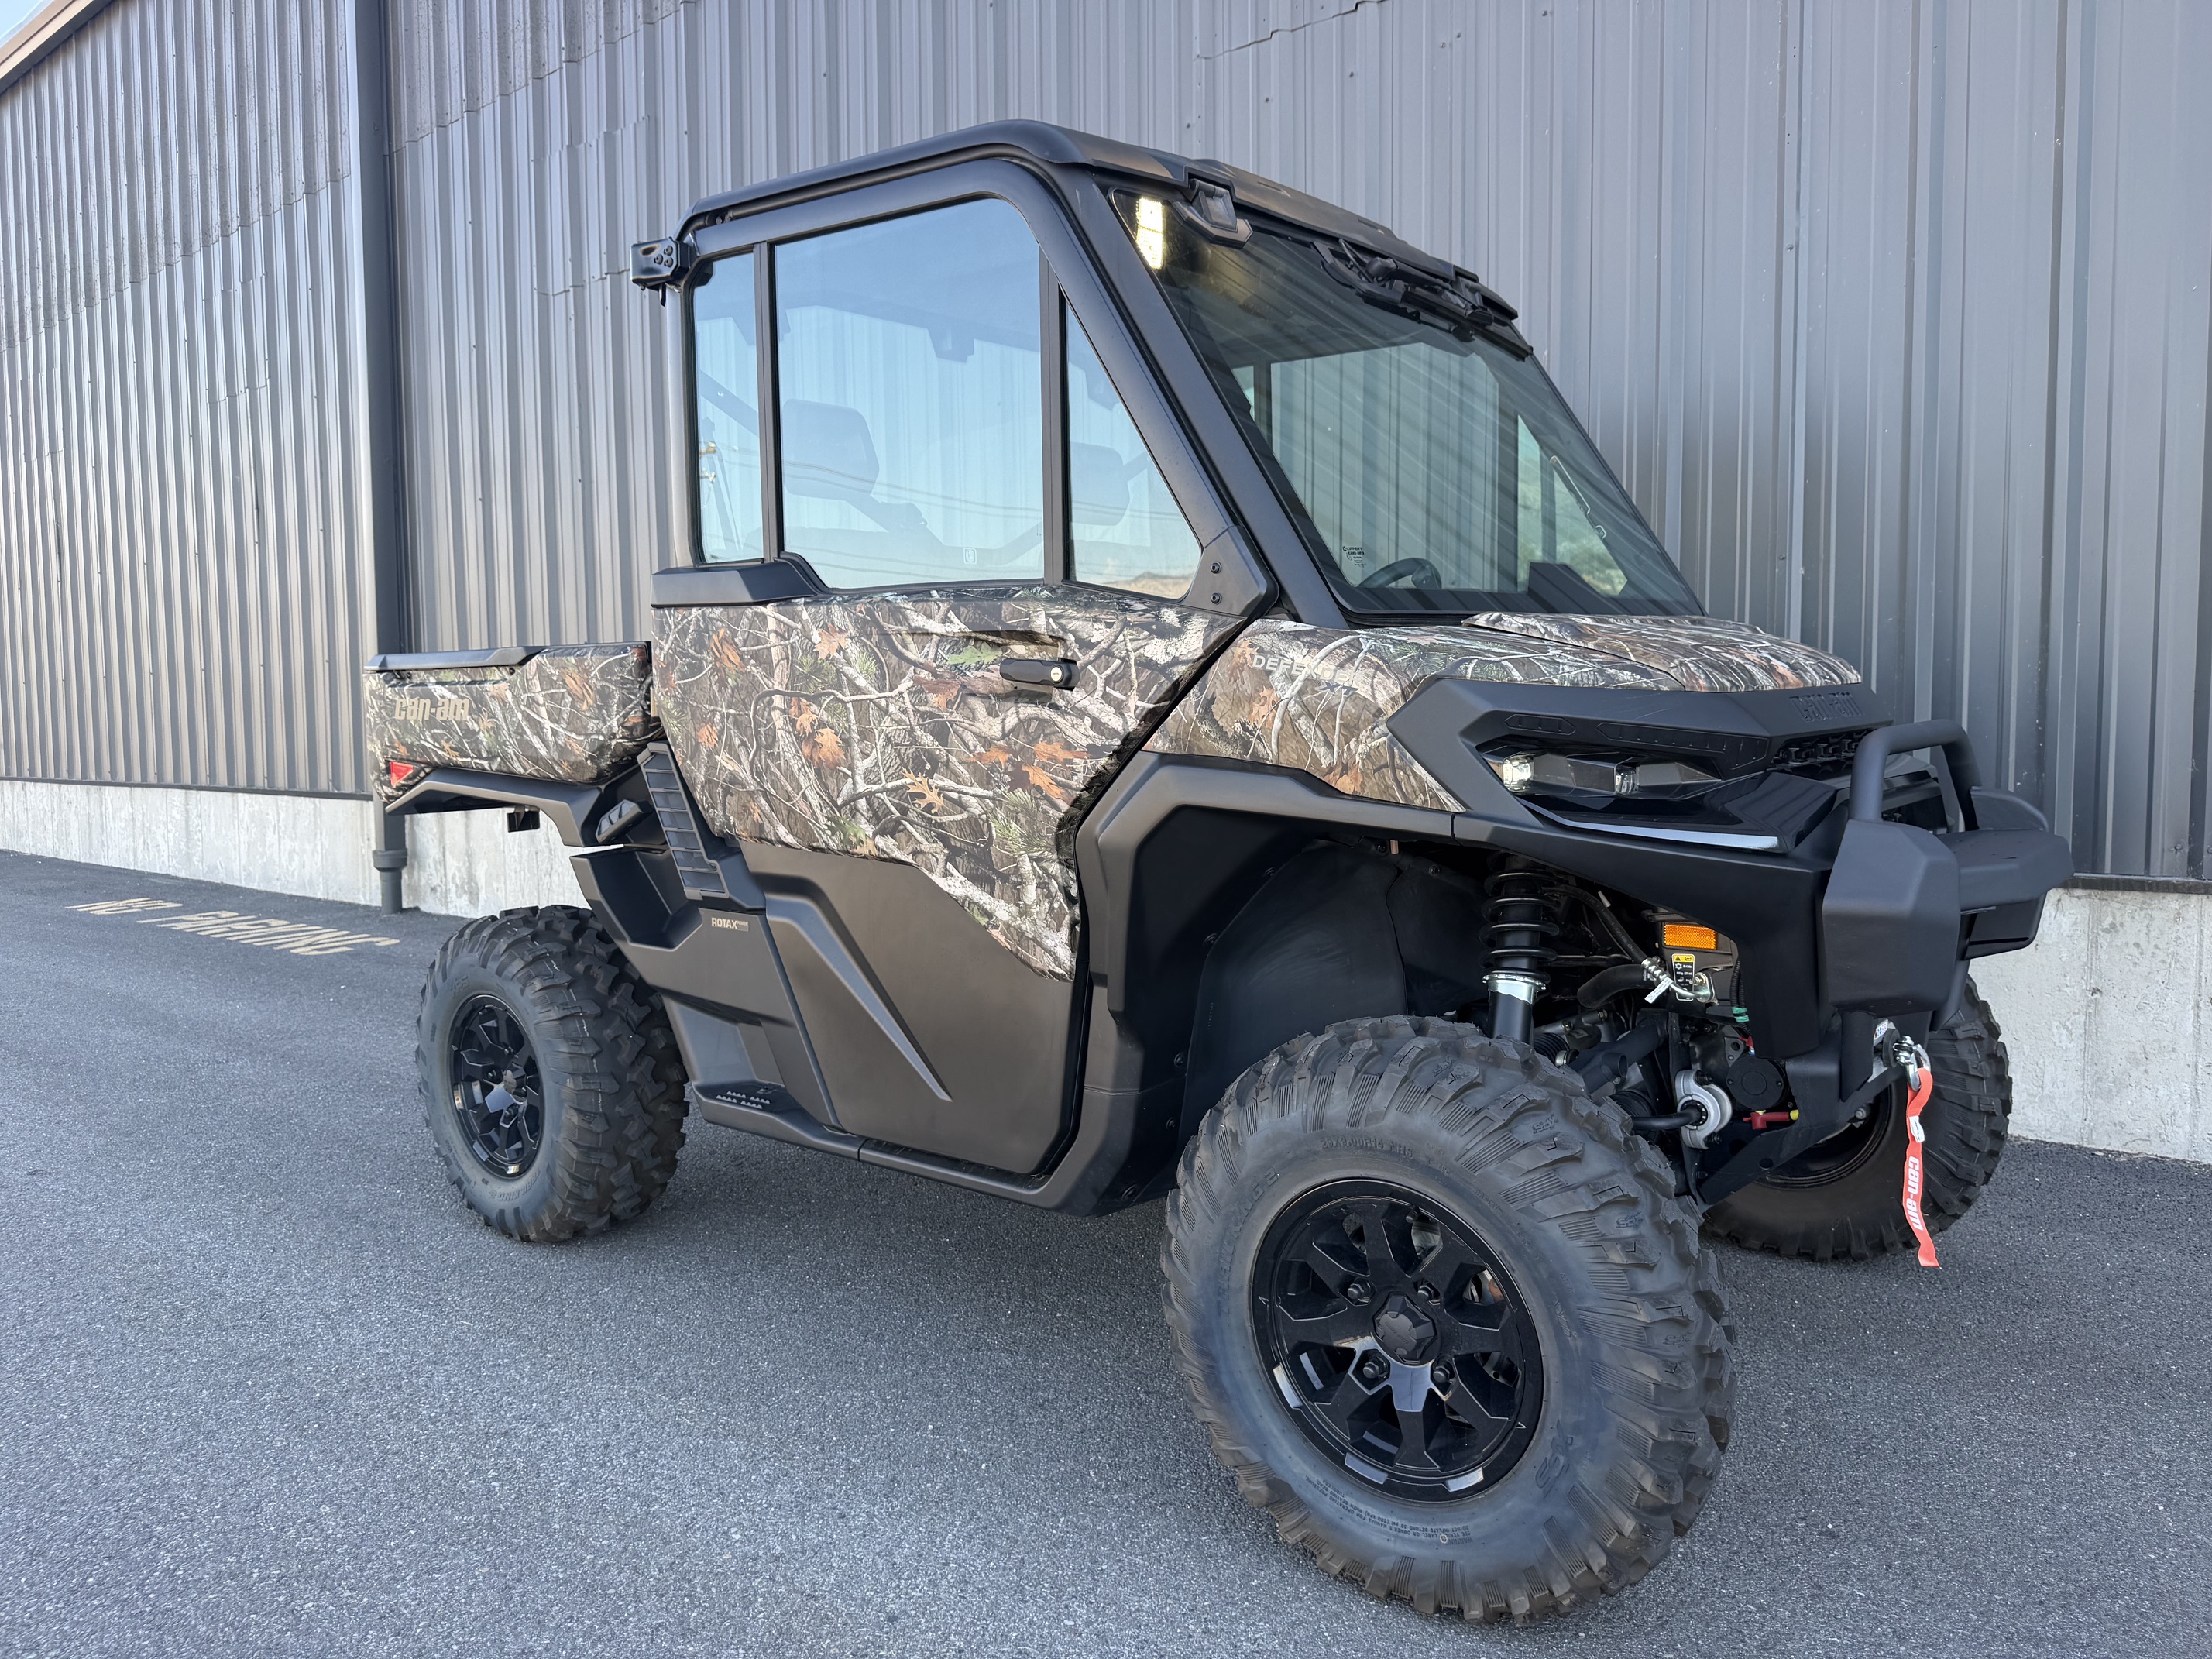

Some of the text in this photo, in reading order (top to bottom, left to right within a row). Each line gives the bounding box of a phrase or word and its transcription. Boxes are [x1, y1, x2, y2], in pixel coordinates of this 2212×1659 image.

[1321, 682, 1359, 696] XT
[65, 897, 400, 955] NO PARKING
[711, 917, 737, 929] ROTAX
[1905, 1156, 1924, 1231] can-am
[1444, 1537, 1473, 1545] WARNIN
